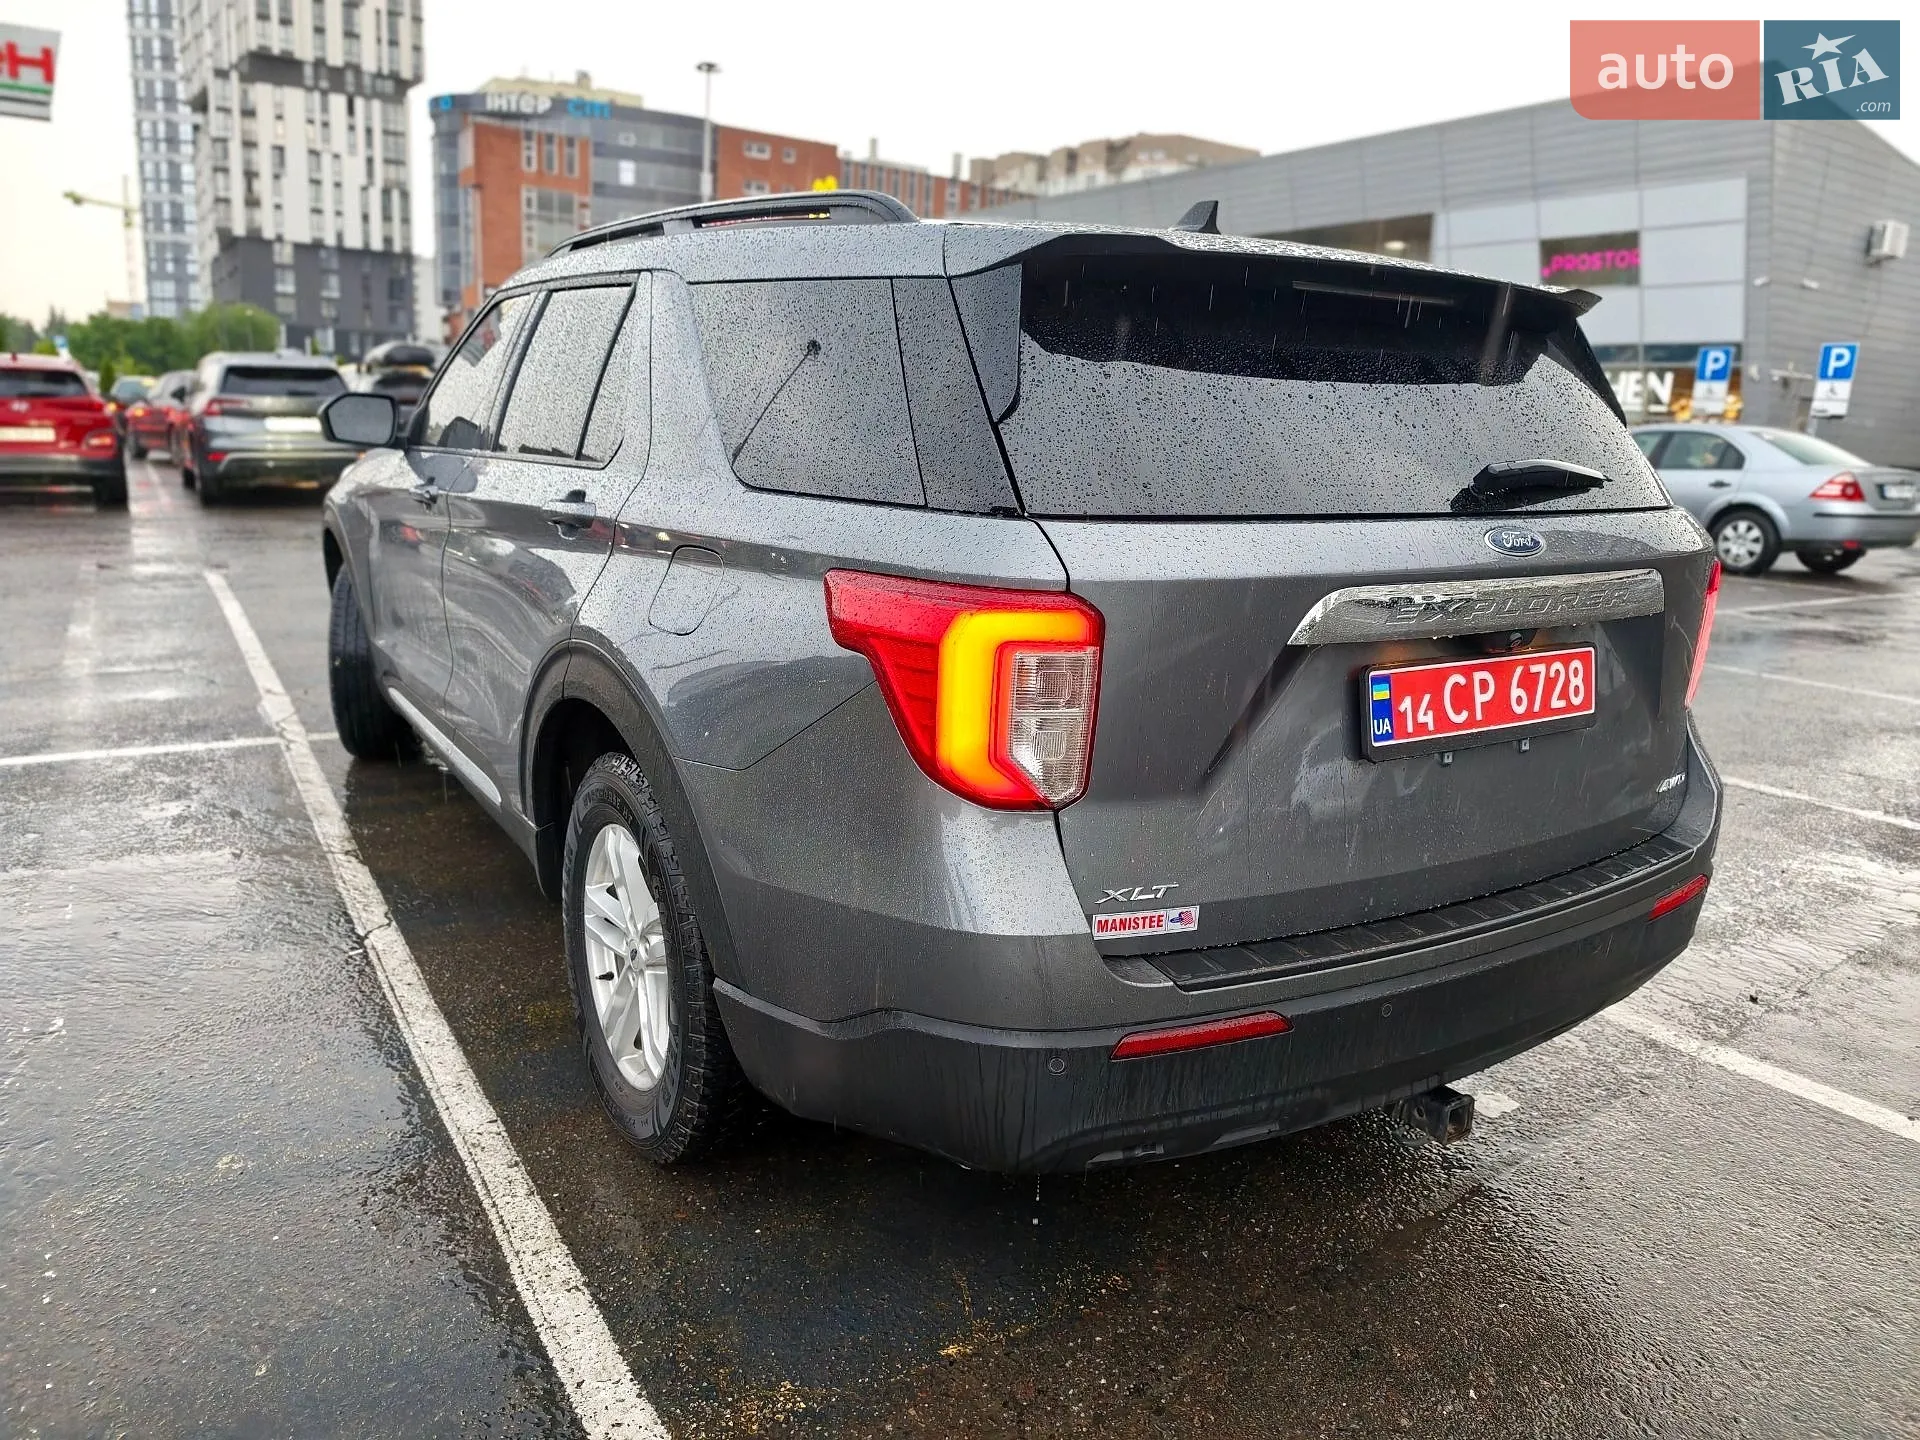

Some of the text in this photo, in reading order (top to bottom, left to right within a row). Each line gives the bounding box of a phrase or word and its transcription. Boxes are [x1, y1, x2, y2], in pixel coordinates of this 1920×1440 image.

[1705, 351, 1726, 379] P
[1827, 348, 1851, 377] P
[1501, 530, 1534, 548] Ford
[1386, 586, 1631, 626] EXPLORER
[1397, 658, 1586, 735] 14 CP 6728
[1373, 718, 1393, 736] UA
[1094, 881, 1180, 905] XLT
[1096, 913, 1165, 935] MANISTEE
